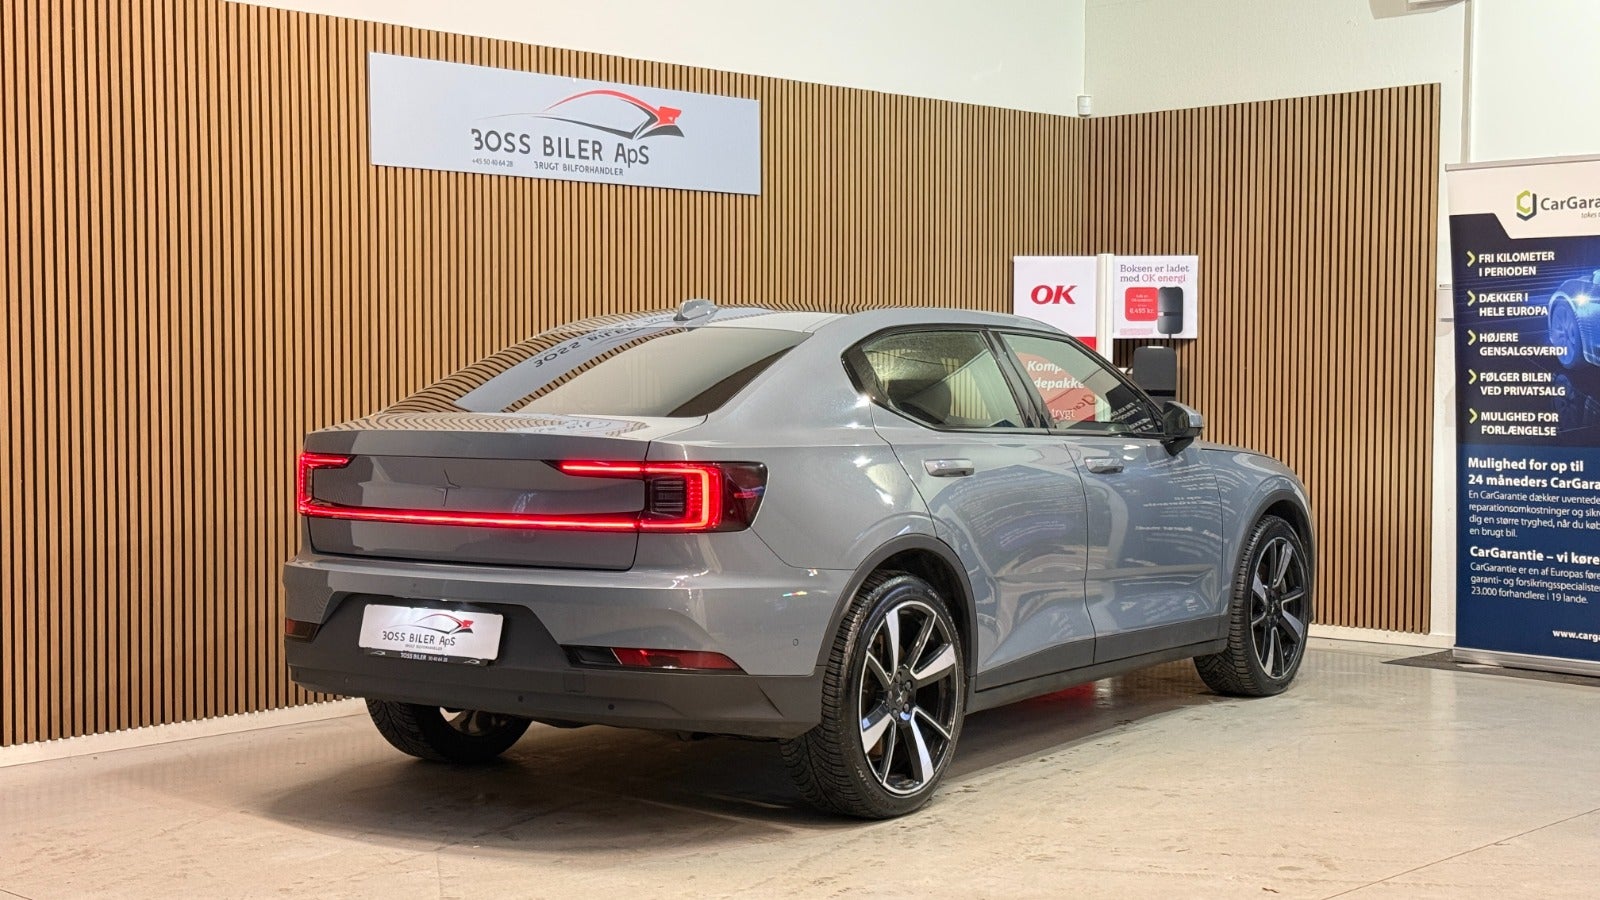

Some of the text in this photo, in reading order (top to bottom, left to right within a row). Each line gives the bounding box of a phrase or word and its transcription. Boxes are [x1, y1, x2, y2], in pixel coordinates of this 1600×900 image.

[542, 136, 604, 162] BILER
[614, 142, 650, 168] ApS
[562, 164, 624, 176] BILFORHANDLER
[1478, 252, 1555, 263] FRI KILOMETER
[1167, 264, 1190, 272] ladet
[1479, 266, 1536, 276] I PERIODEN
[1158, 274, 1186, 284] energi
[1030, 285, 1078, 304] OK
[1479, 293, 1528, 303] DÆKKER I
[1480, 306, 1548, 316] HELE EUROPA
[1480, 333, 1519, 342] HØJERE
[1480, 347, 1568, 356] GENSALGSVÆRDI
[1480, 372, 1551, 382] FØLGER BILEN
[1481, 386, 1565, 396] VED PRIVATSALG
[1481, 412, 1558, 422] MULIGHED FOR
[1481, 425, 1556, 436] FORLÆNGELSE
[1468, 458, 1584, 474] Mulighed for op til
[1468, 474, 1483, 484] 24
[1486, 475, 1547, 487] måneders
[1469, 490, 1478, 498] En
[1480, 490, 1527, 501] CarGarantie
[1529, 493, 1559, 503] dækker
[1469, 503, 1569, 517] reparationsomkostninger
[1572, 509, 1583, 518] og
[1469, 515, 1482, 524] dig
[1496, 516, 1519, 525] større
[1521, 518, 1555, 528] tryghed,
[1557, 519, 1571, 528] når
[1572, 520, 1584, 529] du
[1482, 528, 1504, 538] brugt
[1506, 528, 1517, 537] bil.
[1470, 546, 1544, 561] CarGarantie
[1556, 552, 1568, 563] vi
[1470, 562, 1517, 573] CarGarantie
[1541, 567, 1548, 575] af
[1551, 568, 1583, 579] Europas
[1471, 575, 1501, 584] garanti-
[1503, 578, 1514, 587] og
[1472, 586, 1497, 596] 23.000
[1499, 588, 1545, 600] forhandlere
[1563, 593, 1589, 604] lande.
[409, 633, 435, 644] BILER
[439, 637, 456, 647] ApS
